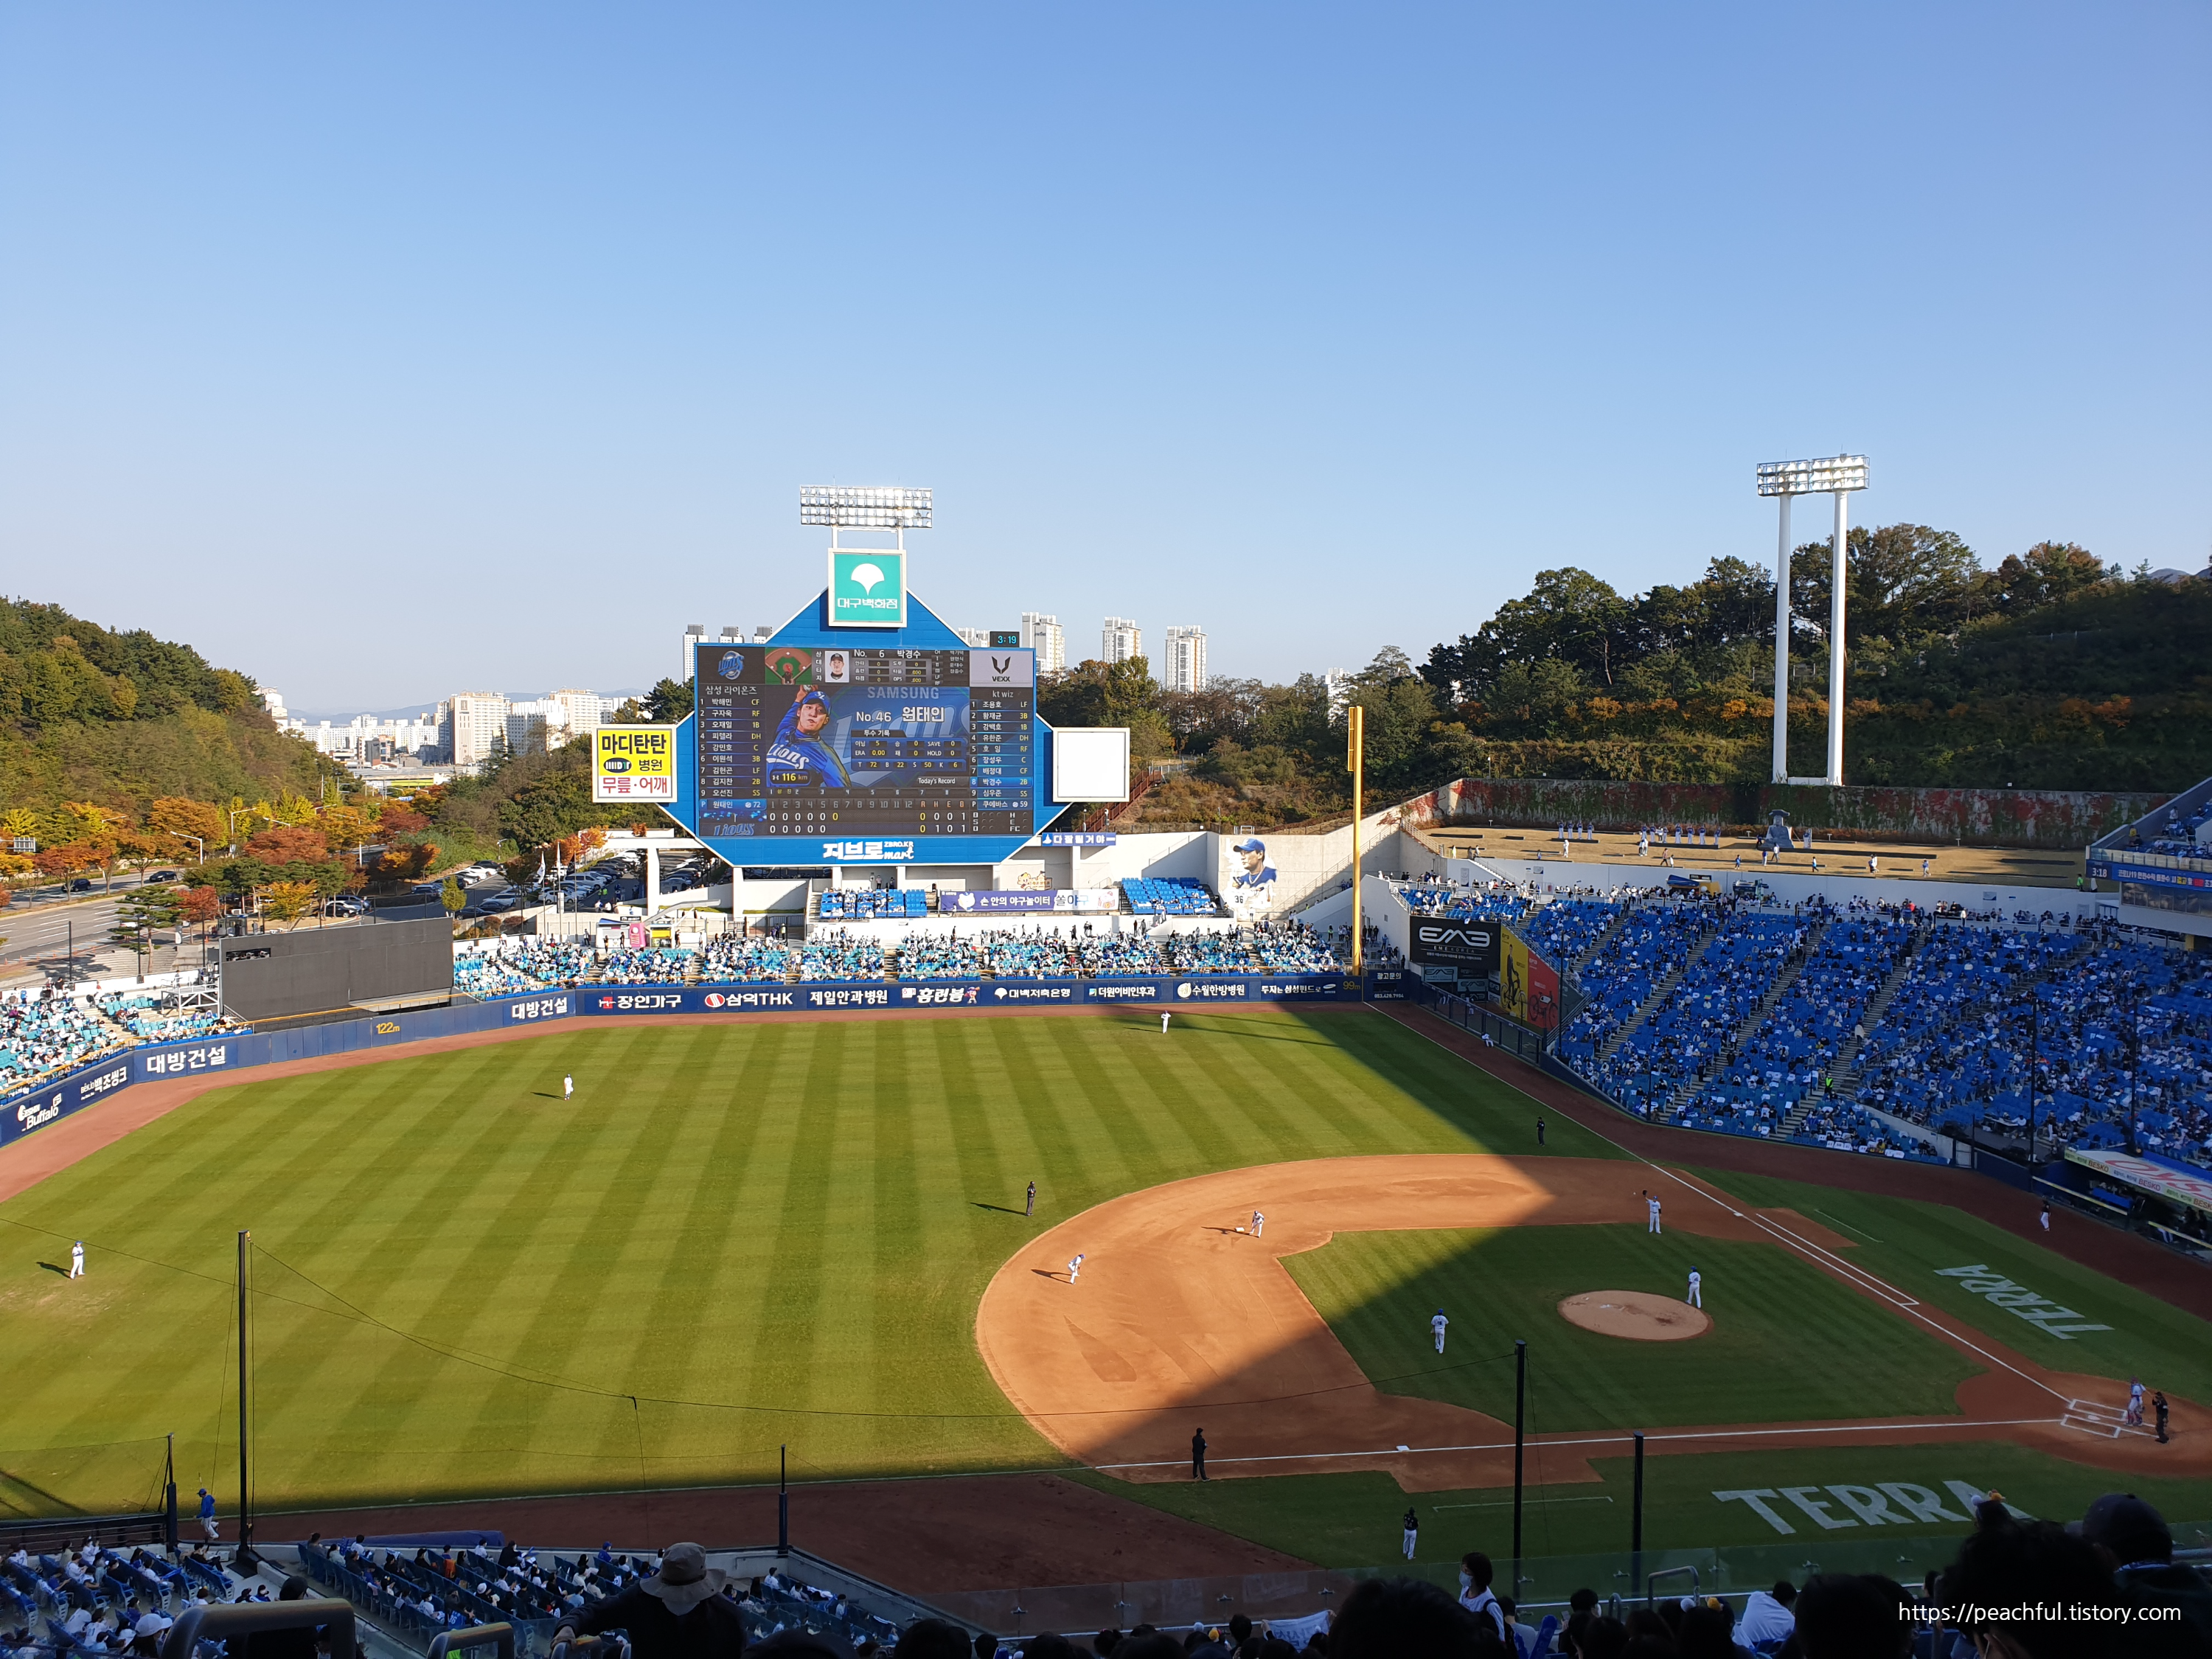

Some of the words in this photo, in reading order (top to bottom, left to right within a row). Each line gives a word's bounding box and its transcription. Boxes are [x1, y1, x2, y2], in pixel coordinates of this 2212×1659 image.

[838, 598, 897, 608] 대구백화점
[897, 650, 921, 658] 박경수
[706, 686, 722, 695] 삼성
[724, 686, 757, 695] 라이온즈
[868, 687, 939, 699] SAMSUNG
[983, 700, 1001, 709] 조용호
[902, 707, 945, 722] 원태인
[983, 712, 1001, 720] 황재균
[983, 723, 1001, 731] 강백호
[602, 734, 667, 754] 마디탄탄
[712, 743, 732, 751] 강민호
[639, 759, 662, 771] 병원
[782, 773, 796, 782] 116
[983, 778, 1002, 786] 박경수
[983, 789, 1001, 797] 심우준
[823, 841, 884, 860] 지브로
[884, 847, 914, 860] mart
[981, 897, 989, 906] 손
[991, 897, 1006, 906] 안의
[1192, 984, 1245, 996] 수월한방병원
[1343, 981, 1360, 990] 99m
[810, 990, 888, 1005] 제일안과병원
[1009, 988, 1071, 998] 대백저축은행
[1099, 987, 1155, 998] 더원이비인후과
[617, 995, 681, 1009] 장인가구
[726, 992, 793, 1006] 삼익THK
[512, 997, 567, 1020] 대방건설
[375, 1022, 400, 1034] 122m
[147, 1046, 226, 1074] 대방건설
[94, 1066, 127, 1092] 백조씽크
[27, 1106, 58, 1130] Buffalo
[2088, 1161, 2110, 1172] BESKO
[2139, 1178, 2160, 1191] BESKO
[1933, 1265, 2115, 1340] TERRA
